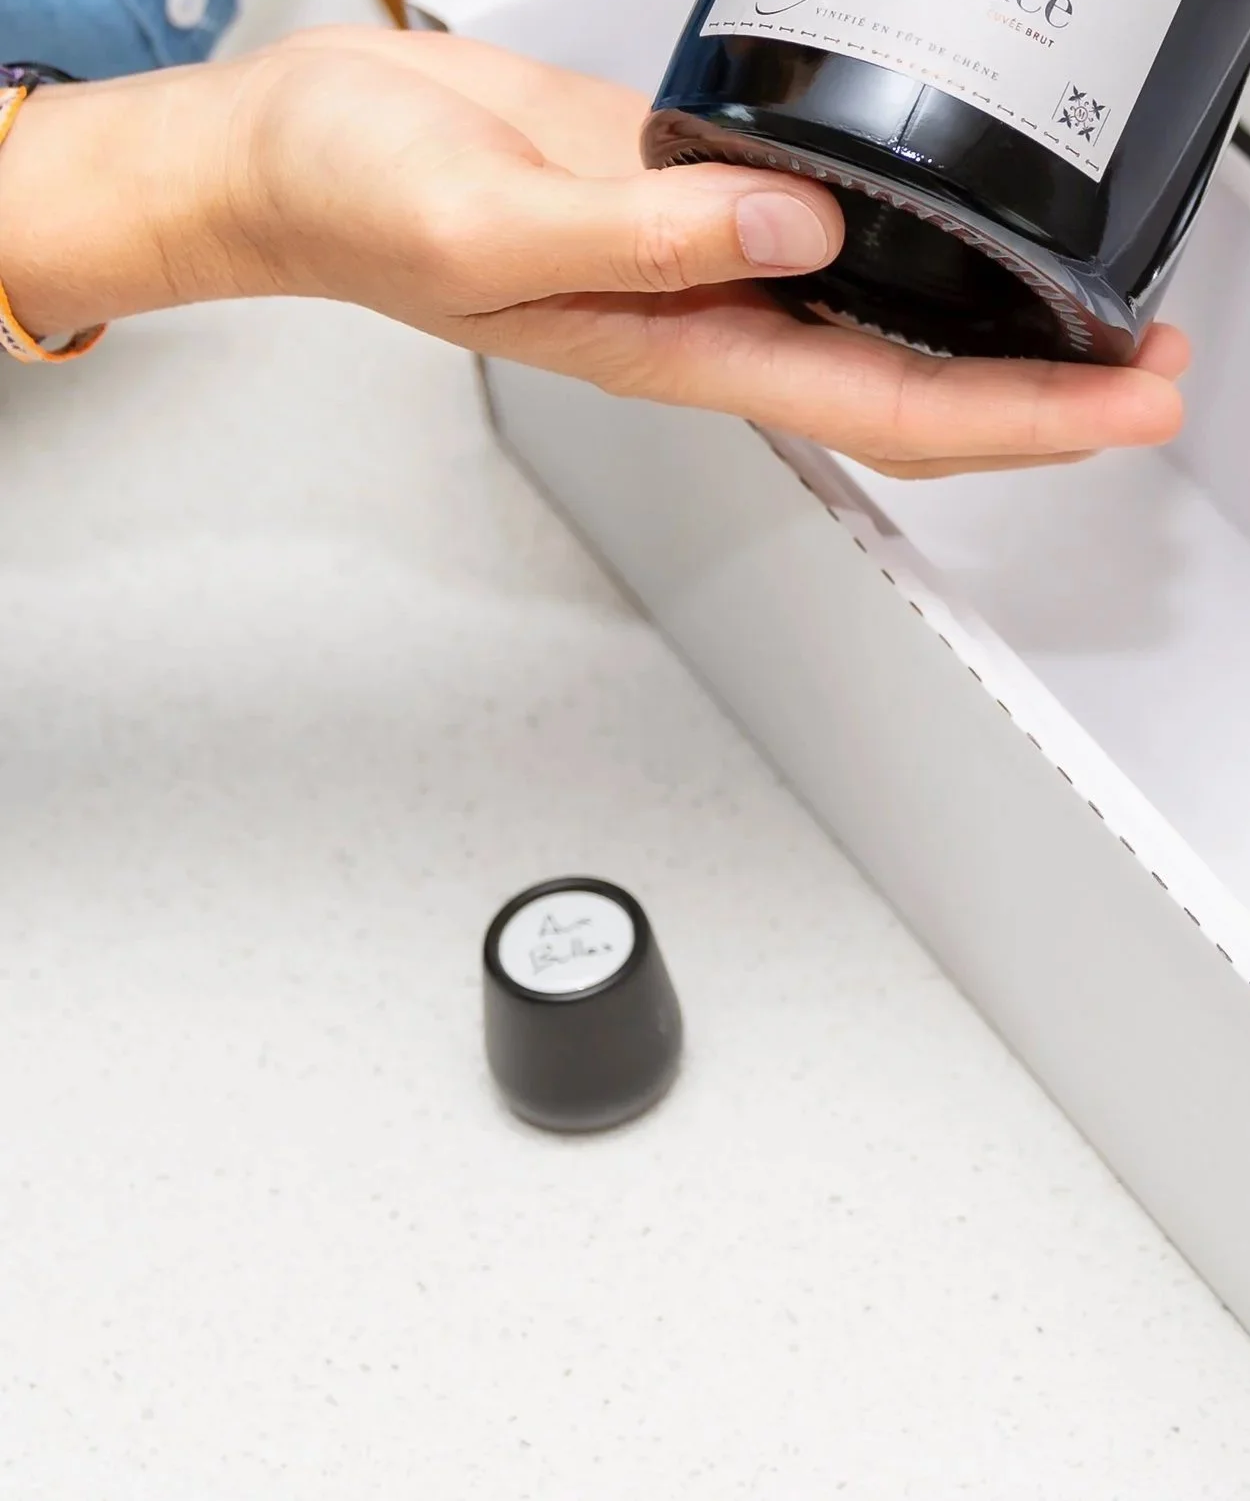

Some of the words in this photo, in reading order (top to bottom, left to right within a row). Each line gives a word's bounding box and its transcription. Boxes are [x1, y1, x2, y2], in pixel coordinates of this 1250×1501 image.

[815, 6, 867, 28] VINIFIÉ
[871, 21, 891, 35] EN
[928, 41, 947, 56] DE
[1024, 27, 1056, 49] BRUT
